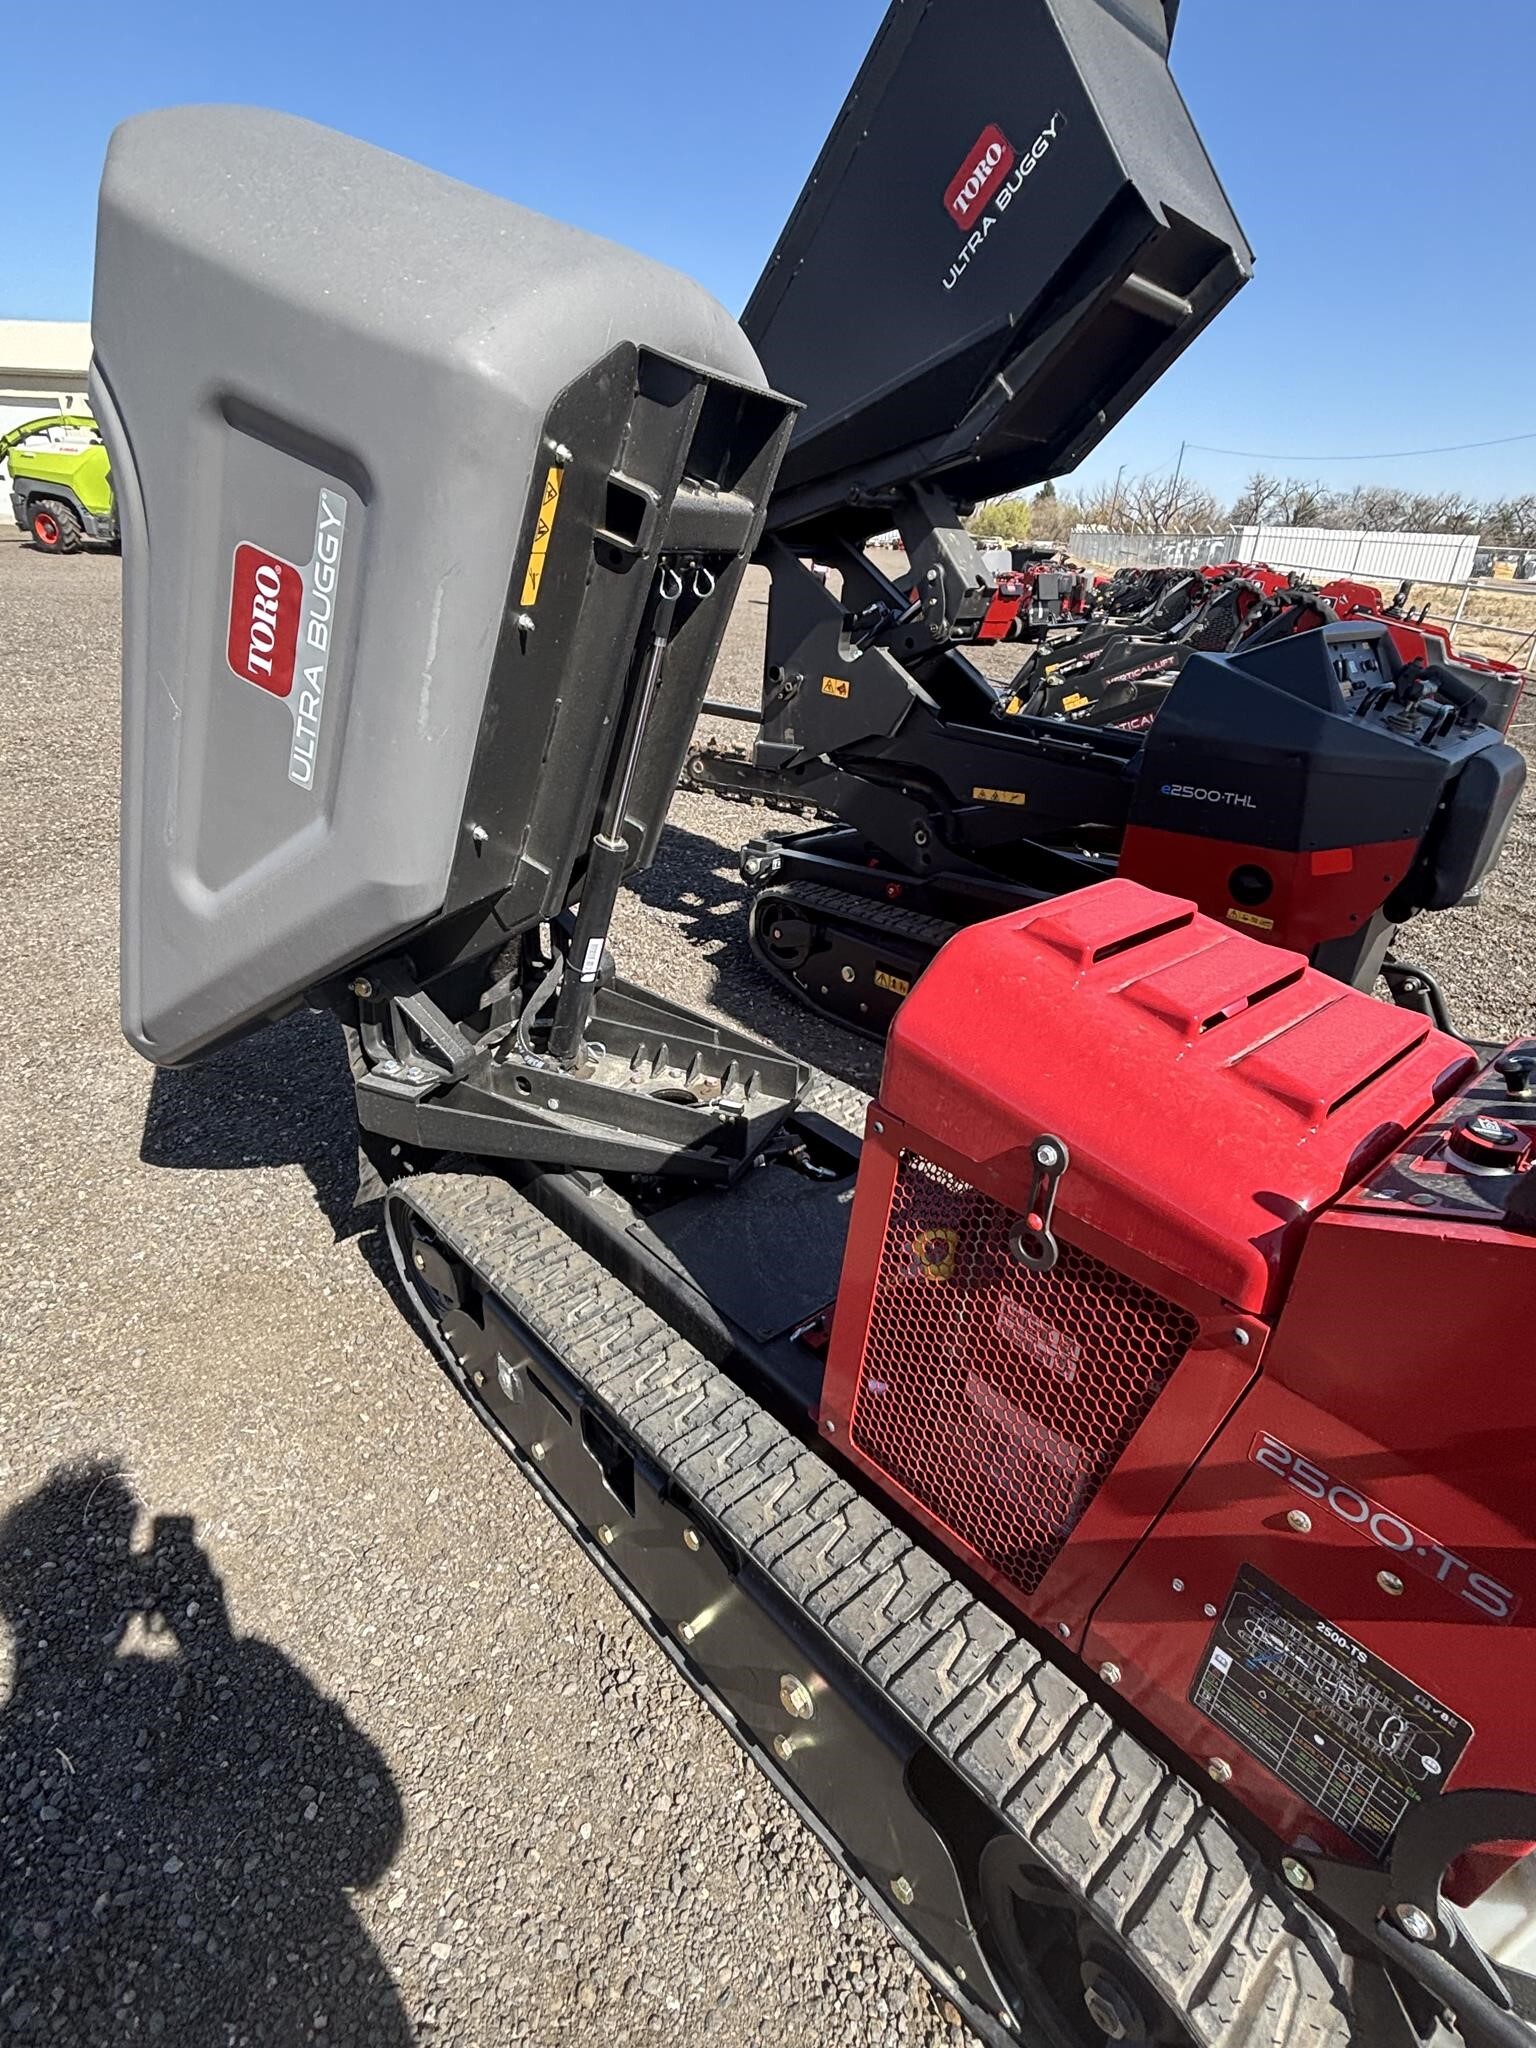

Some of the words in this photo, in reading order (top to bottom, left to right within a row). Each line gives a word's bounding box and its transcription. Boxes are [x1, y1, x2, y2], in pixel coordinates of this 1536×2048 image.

[942, 215, 997, 289] ULTRA
[995, 112, 1059, 212] BUGGY
[953, 142, 1006, 214] TORO
[247, 565, 281, 677] TORO
[306, 493, 343, 653] BUGGY
[290, 666, 324, 784] ULTRA
[1316, 1621, 1368, 1664] 2500-TS
